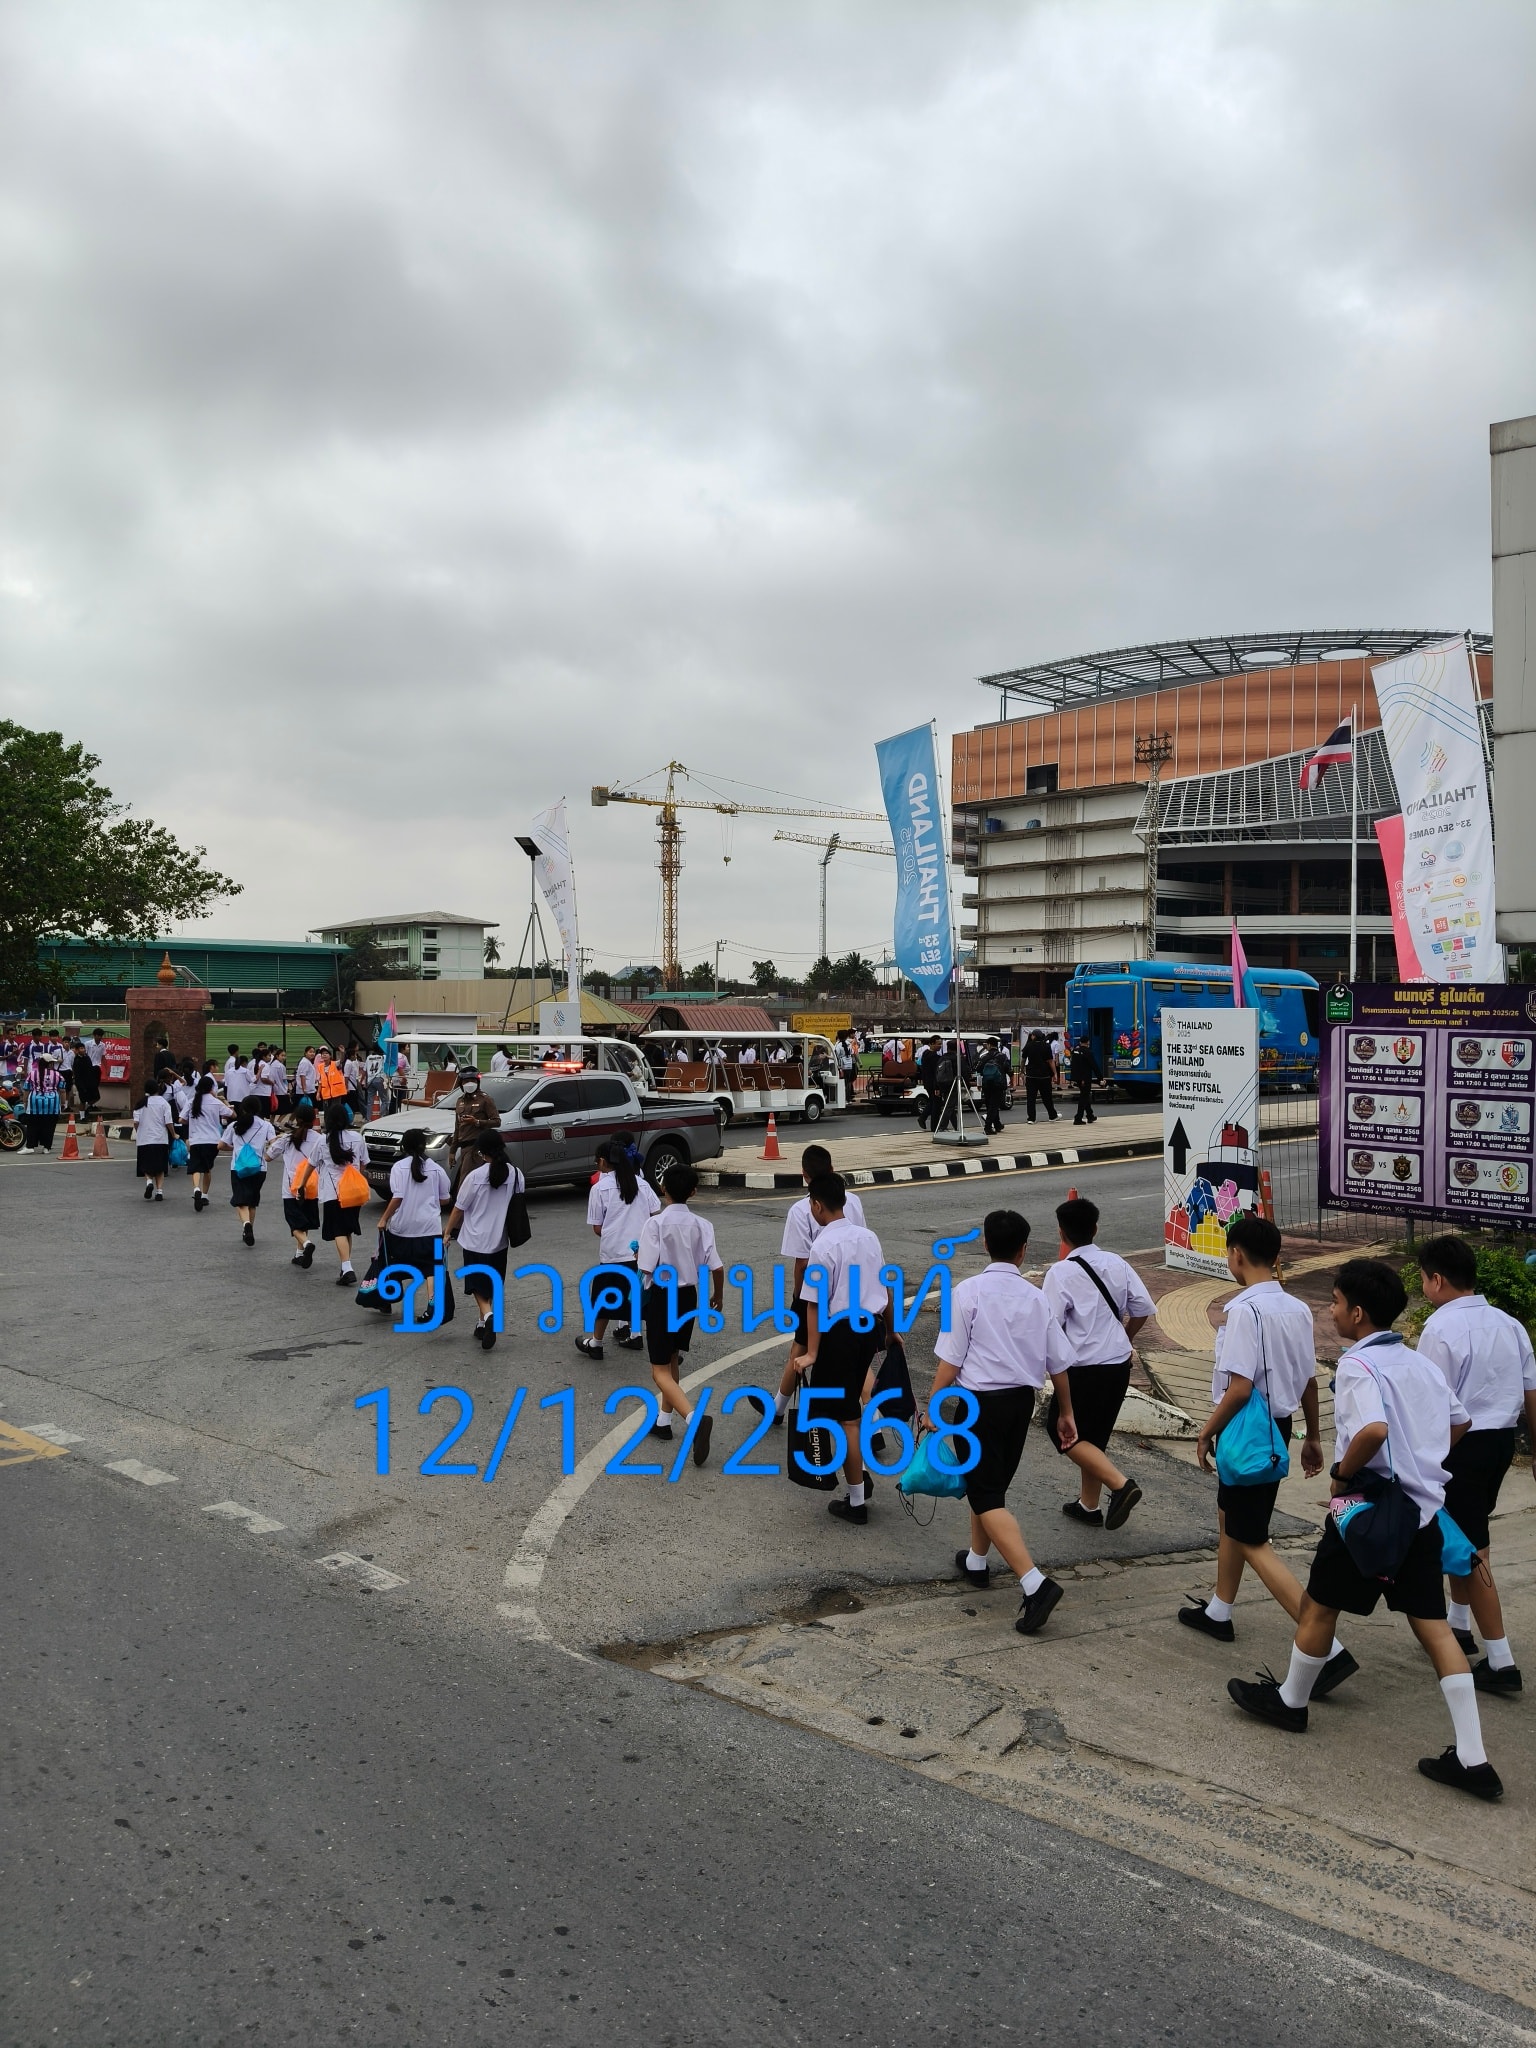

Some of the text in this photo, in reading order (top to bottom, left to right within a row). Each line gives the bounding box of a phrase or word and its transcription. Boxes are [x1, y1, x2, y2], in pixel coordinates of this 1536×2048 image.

[1394, 987, 1485, 1006] นนทบุรี ยูไนเต็ด
[1177, 1021, 1213, 1030] THAILAND
[1167, 1043, 1181, 1054] THE
[1199, 1045, 1215, 1055] SEA
[1216, 1045, 1245, 1056] GAMES
[1167, 1056, 1205, 1067] THAILAND
[1168, 1080, 1221, 1093] MEN'S FUTSAL
[544, 1151, 568, 1160] POLICE
[1513, 1195, 1530, 1203] 2568
